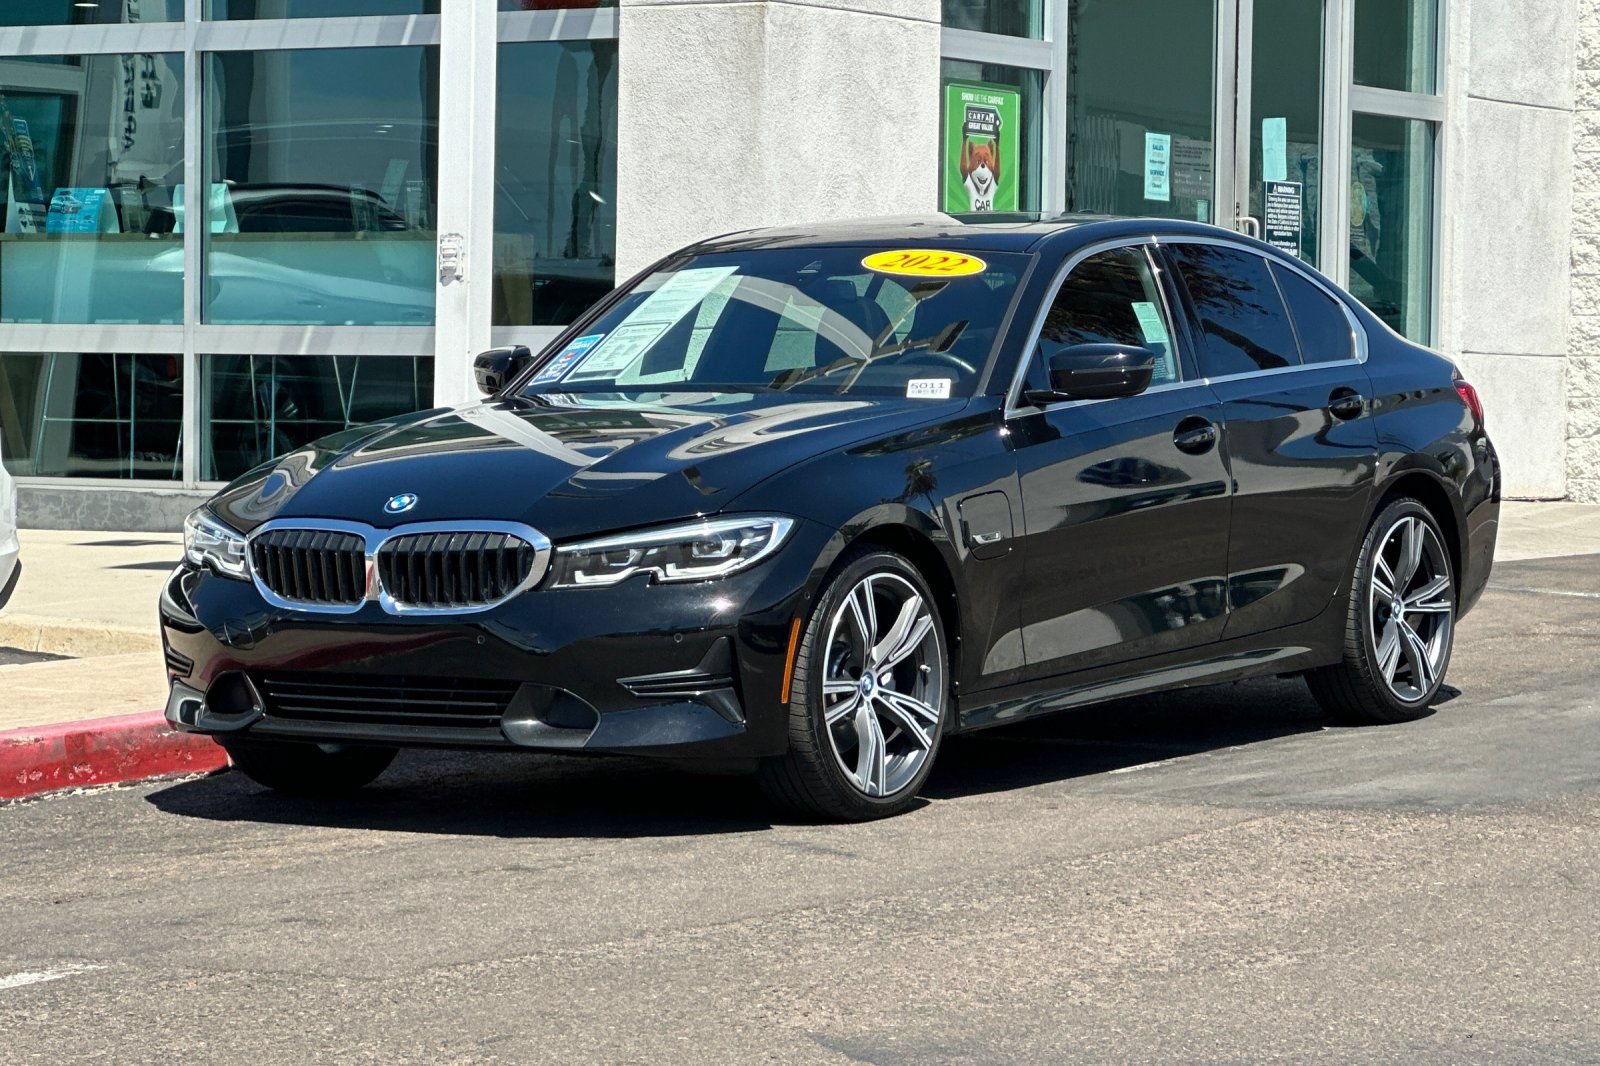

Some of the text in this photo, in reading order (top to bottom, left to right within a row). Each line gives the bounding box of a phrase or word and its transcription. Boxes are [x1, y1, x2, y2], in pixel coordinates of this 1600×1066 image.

[1277, 185, 1295, 194] WARNING
[975, 198, 991, 211] CAR
[879, 254, 969, 271] 2022
